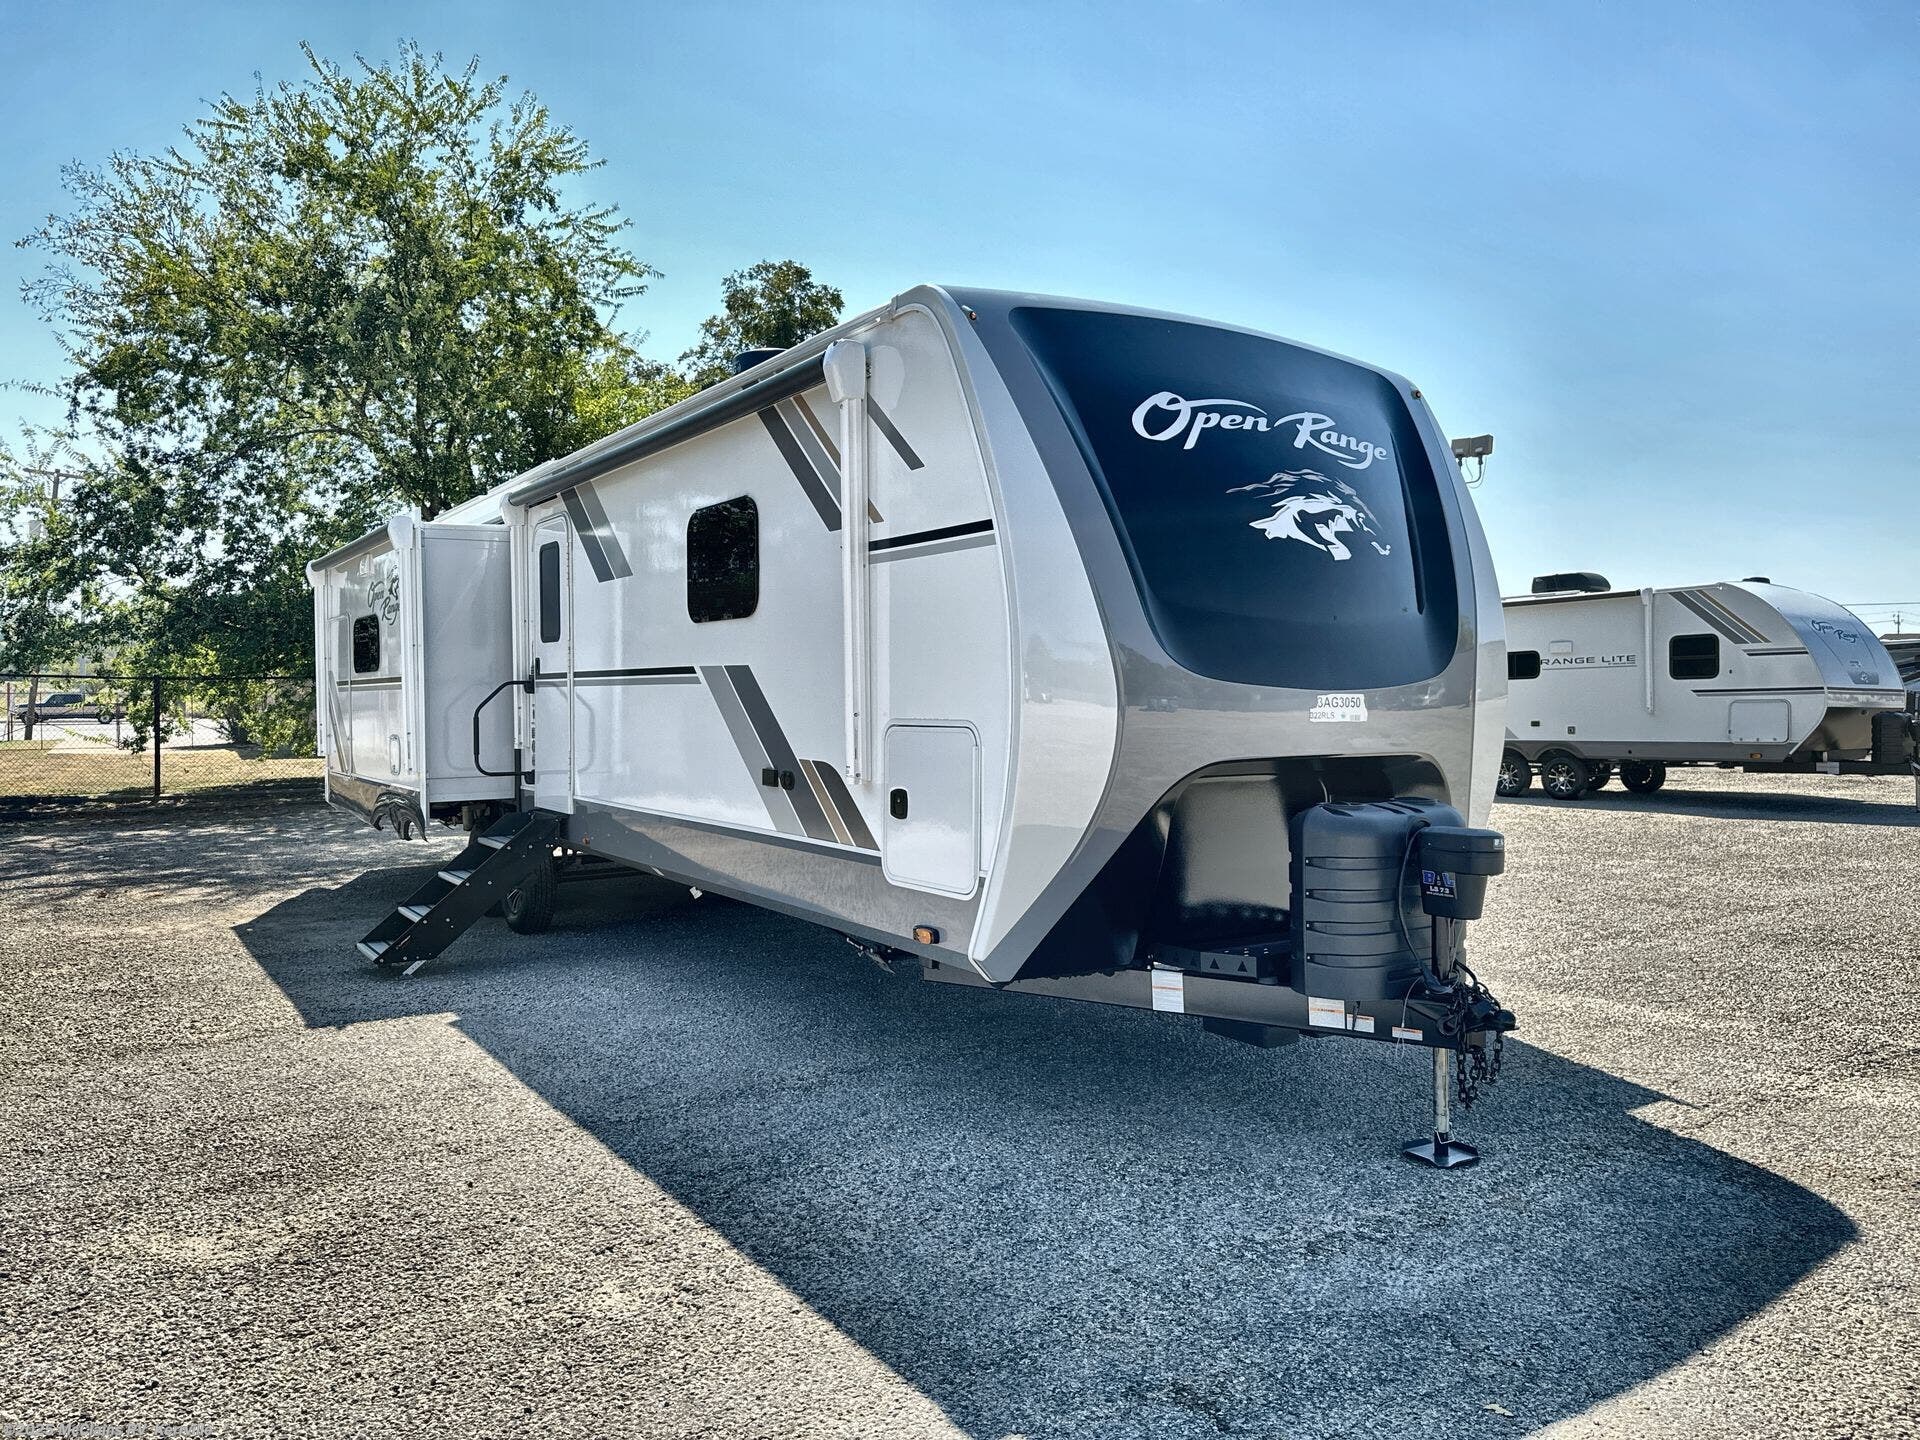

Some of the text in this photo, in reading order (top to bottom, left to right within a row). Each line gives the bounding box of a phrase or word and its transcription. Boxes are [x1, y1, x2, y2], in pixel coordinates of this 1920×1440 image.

[1131, 391, 1389, 470] Open Range
[1540, 654, 1636, 666] RANGE LITE
